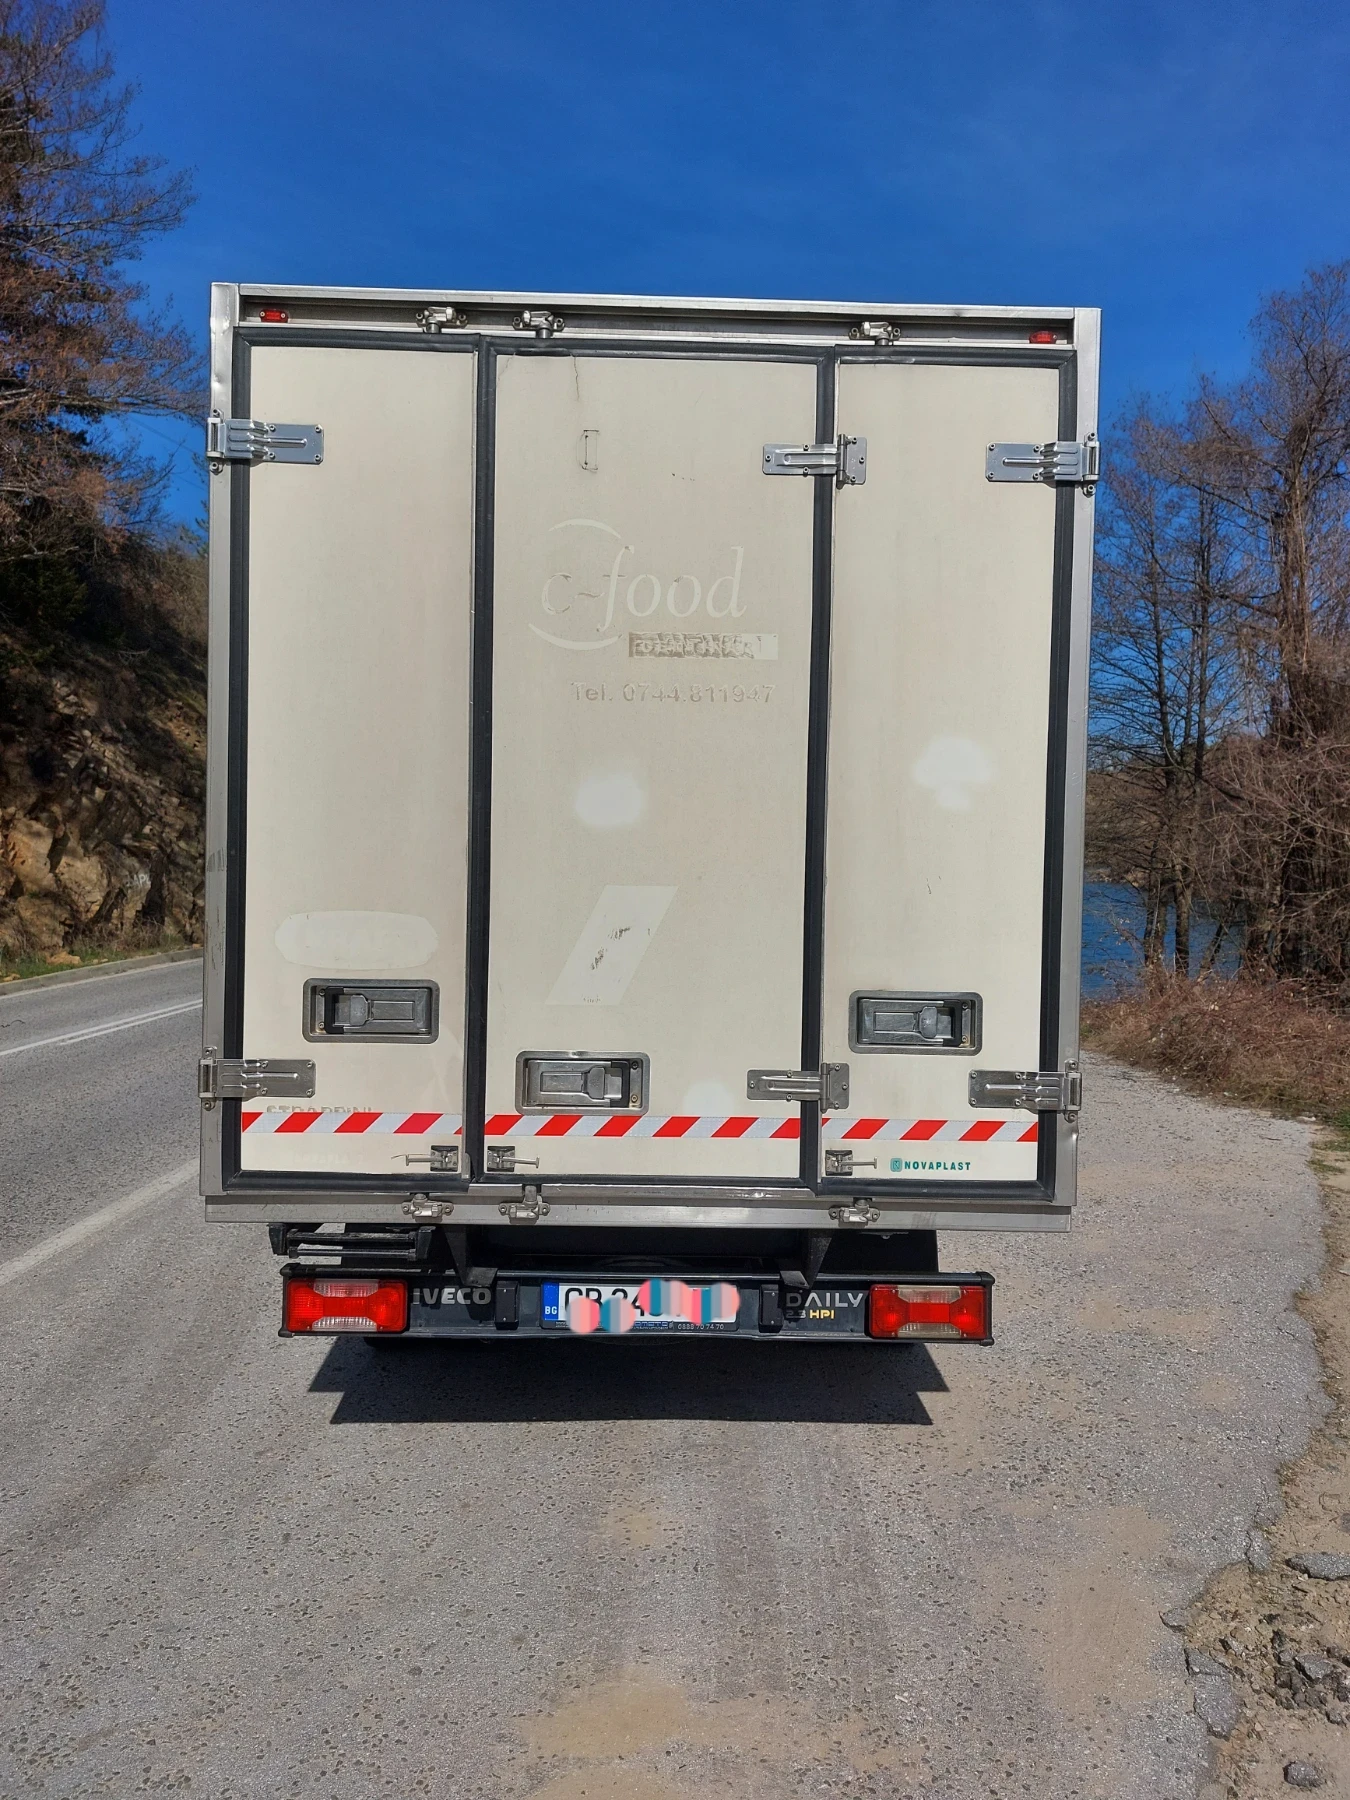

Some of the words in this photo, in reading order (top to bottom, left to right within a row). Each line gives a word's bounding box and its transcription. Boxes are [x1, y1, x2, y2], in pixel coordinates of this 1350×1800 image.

[570, 682, 614, 702] Tel.
[622, 682, 776, 704] 0744.811947
[904, 1161, 971, 1171] NOVAPLAST
[413, 1288, 492, 1305] IVECO
[785, 1292, 864, 1308] DAILY
[544, 1306, 558, 1315] BG
[809, 1309, 835, 1319] HPI
